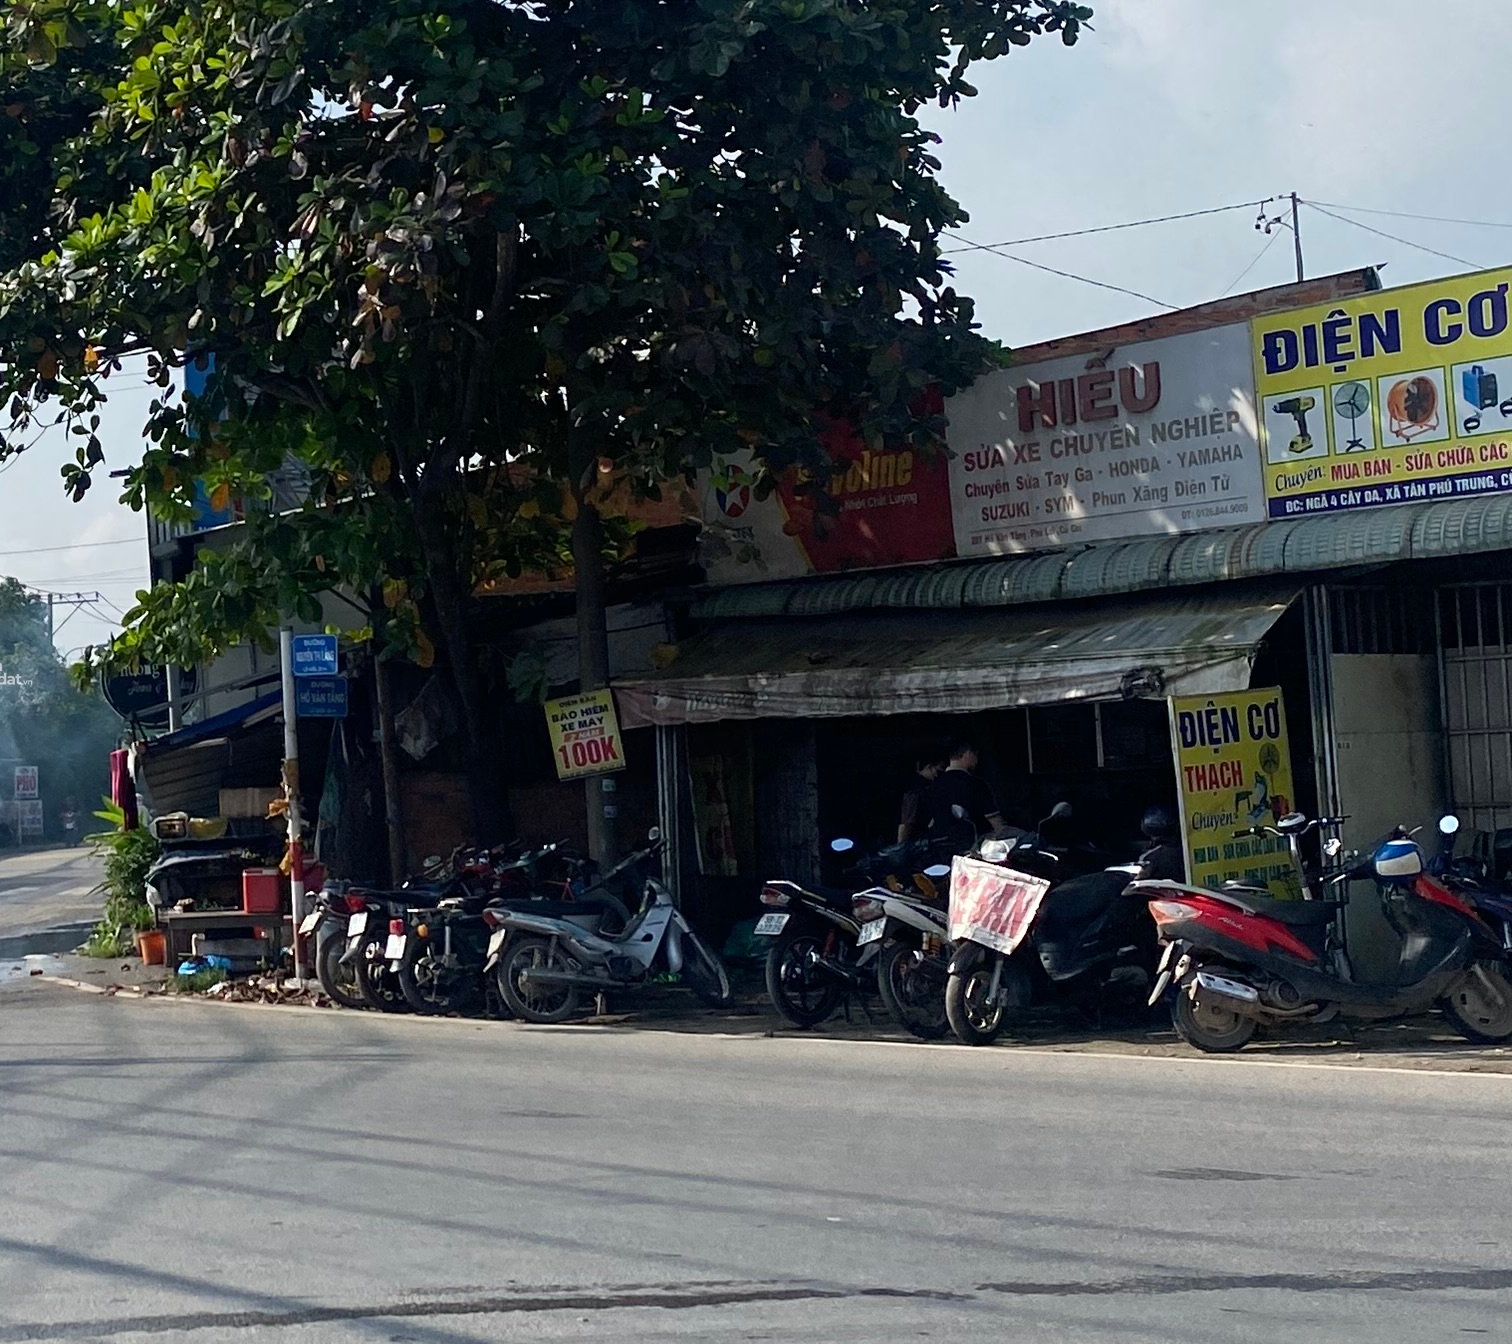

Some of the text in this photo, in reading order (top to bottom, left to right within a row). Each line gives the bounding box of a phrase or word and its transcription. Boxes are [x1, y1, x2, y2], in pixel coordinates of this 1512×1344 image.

[1261, 282, 1509, 375] ĐIỆN CƠ
[1016, 348, 1162, 432] HIẾU
[963, 408, 1241, 472] SỬA XE CHUYÊN NGHIỆP
[965, 443, 1244, 499] Chuyên Sửa Tay Ga HONDA YAMAHA
[1275, 441, 1509, 493] Chuyên: MUA BÁN SỬA CHỮA CÁC
[981, 473, 1231, 522] SUZUKI SYM Phun Xăng Điện Tử
[1285, 499, 1304, 513] ĐC:
[1306, 493, 1329, 511] NGÃ
[1330, 496, 1338, 508] 4
[1340, 487, 1362, 506] CÂY
[1385, 484, 1402, 500] XÃ
[1403, 480, 1427, 497] TÂN
[1429, 476, 1453, 494] PHÚ
[1456, 474, 1499, 492] TRUNG,
[560, 721, 575, 733] XE
[1179, 697, 1281, 754] ĐIỆN CƠ
[558, 735, 619, 769] 100K
[1184, 760, 1244, 796] THẠCH
